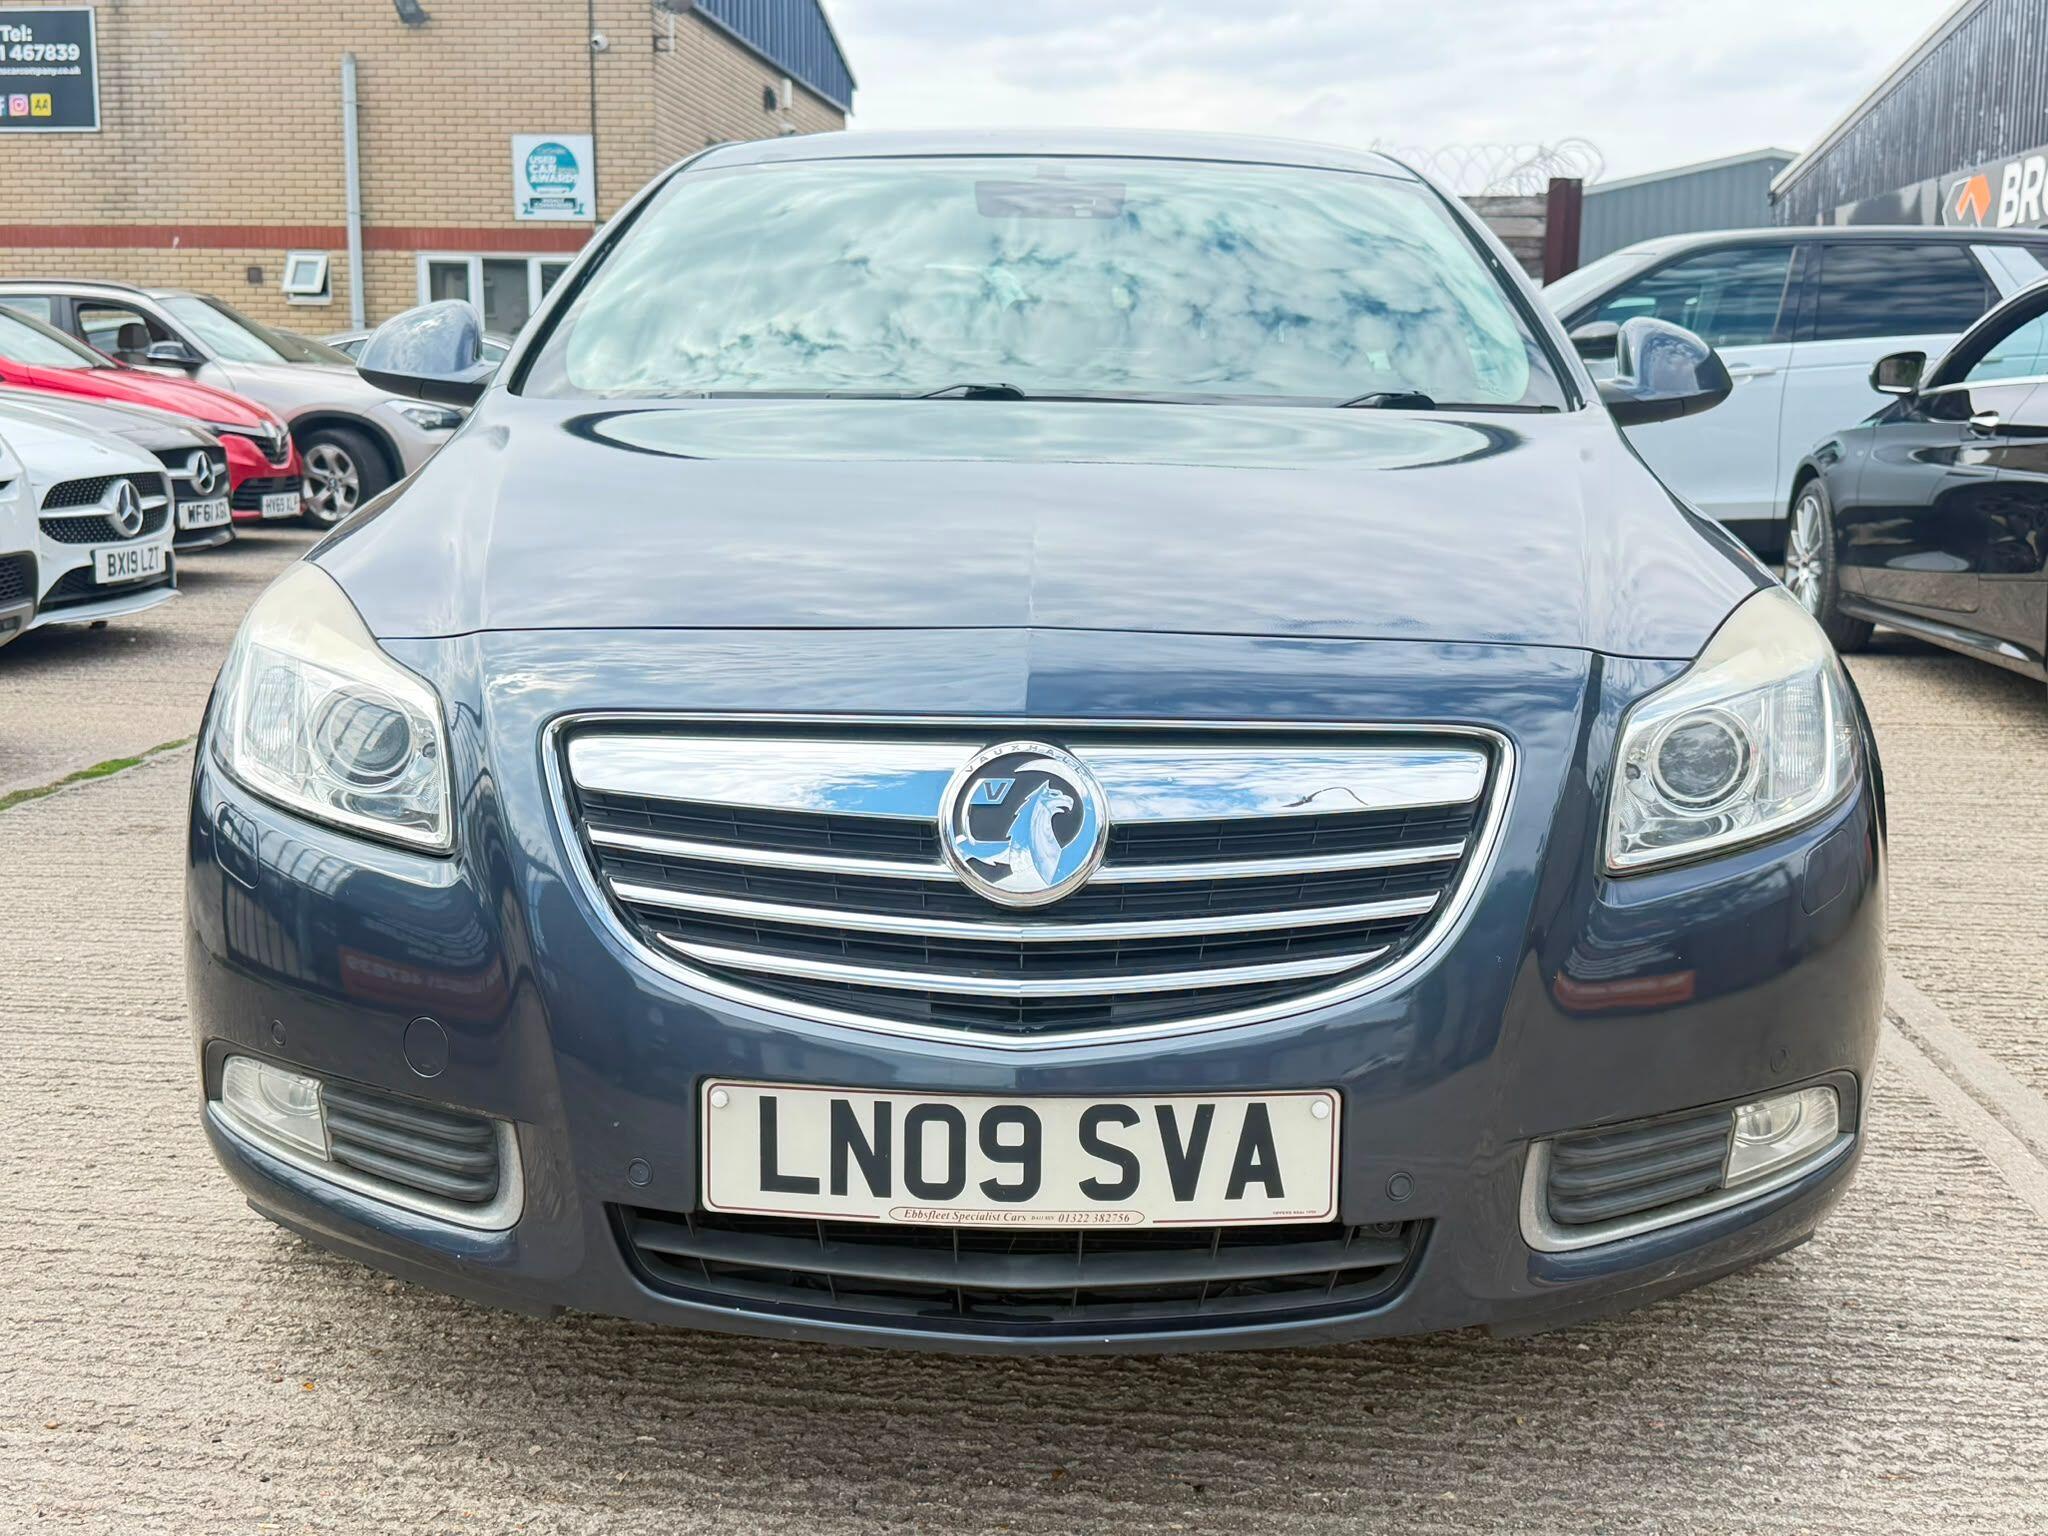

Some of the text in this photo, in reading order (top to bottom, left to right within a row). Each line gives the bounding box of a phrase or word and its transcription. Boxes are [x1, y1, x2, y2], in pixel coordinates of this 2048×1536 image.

[0, 24, 33, 42] Tel:
[9, 43, 80, 61] 467839
[528, 164, 557, 174] CAR
[187, 503, 213, 524] WF61
[107, 546, 159, 577] BX19 LZT
[965, 744, 1087, 775] VAUXHALL
[758, 1095, 1286, 1203] LN09 SVA
[903, 1209, 950, 1221] Ebbsfleet
[952, 1211, 1001, 1223] Specialist
[1003, 1212, 1027, 1222] Cars
[1058, 1213, 1090, 1223] 01322
[1093, 1214, 1130, 1223] 382756
